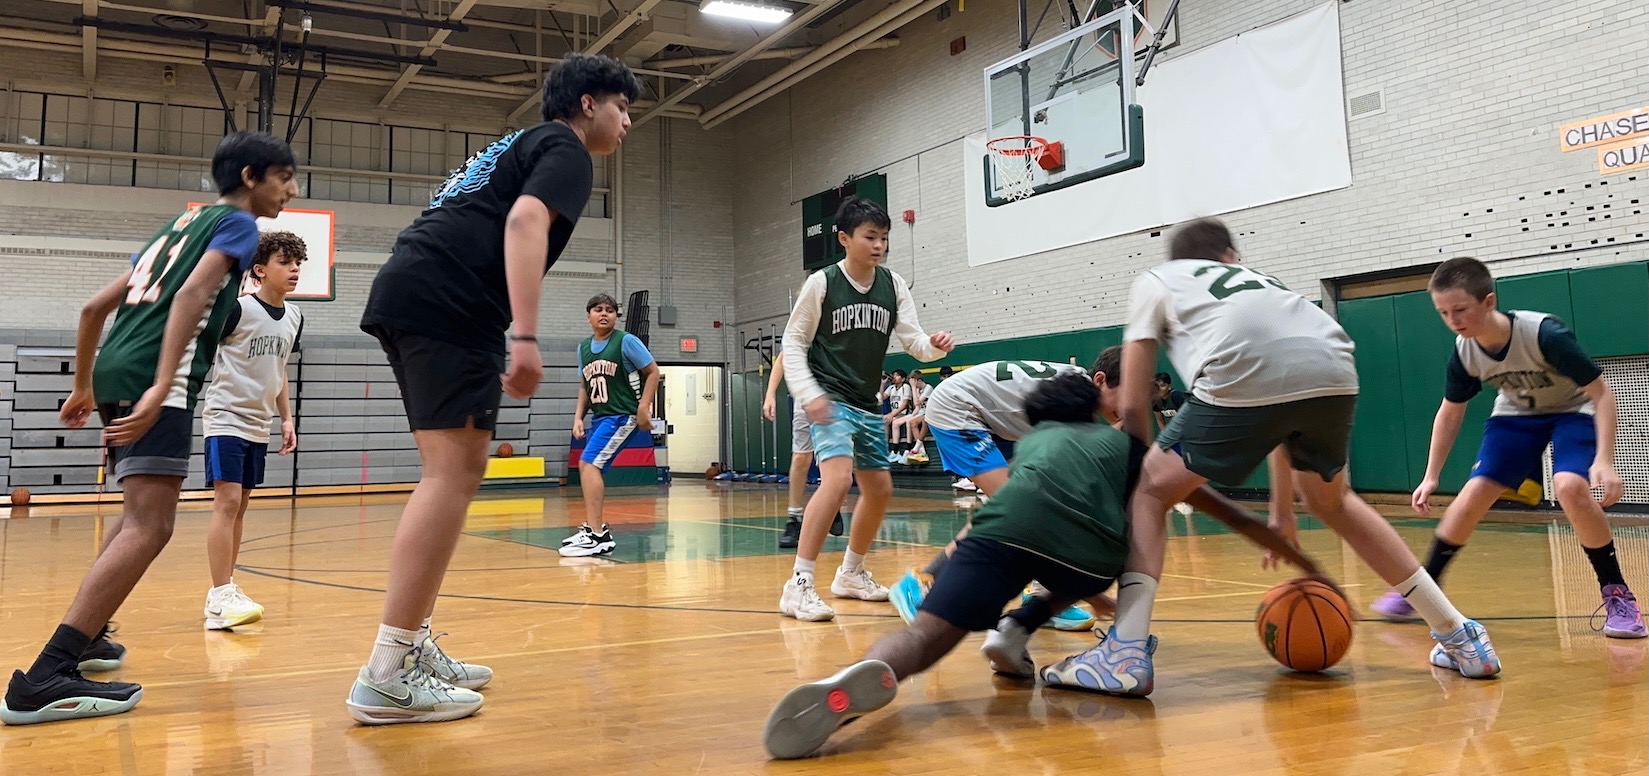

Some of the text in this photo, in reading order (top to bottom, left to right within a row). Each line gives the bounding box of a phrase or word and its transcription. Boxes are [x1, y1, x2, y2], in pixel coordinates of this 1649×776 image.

[1565, 113, 1649, 147] CHASE
[806, 223, 823, 238] HOME
[125, 234, 189, 304] 41
[831, 303, 891, 335] HOPKINTON
[590, 375, 609, 404] 20
